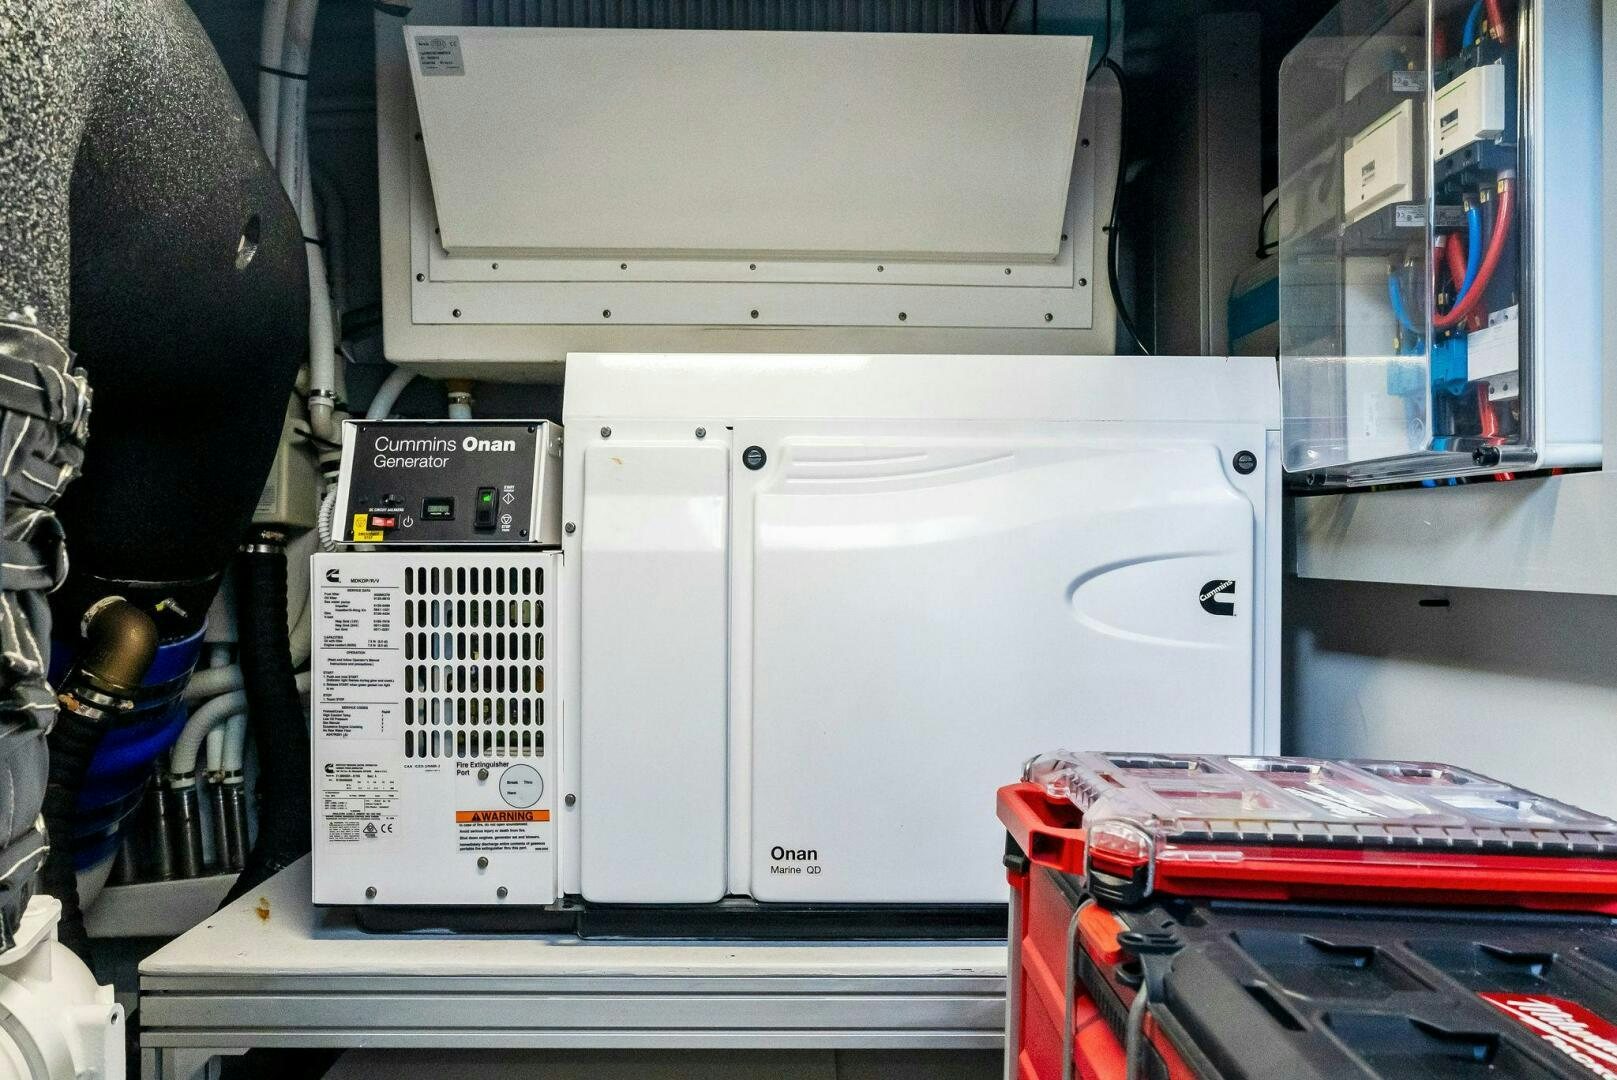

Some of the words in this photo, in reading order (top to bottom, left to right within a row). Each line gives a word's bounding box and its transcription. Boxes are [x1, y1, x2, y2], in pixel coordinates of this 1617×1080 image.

[375, 436, 456, 452] Cummins
[462, 436, 516, 452] Onan
[374, 454, 450, 468] Generator
[1200, 579, 1233, 601] Cummins
[482, 811, 533, 821] WARNING
[771, 846, 817, 860] Onan
[807, 866, 821, 874] QD
